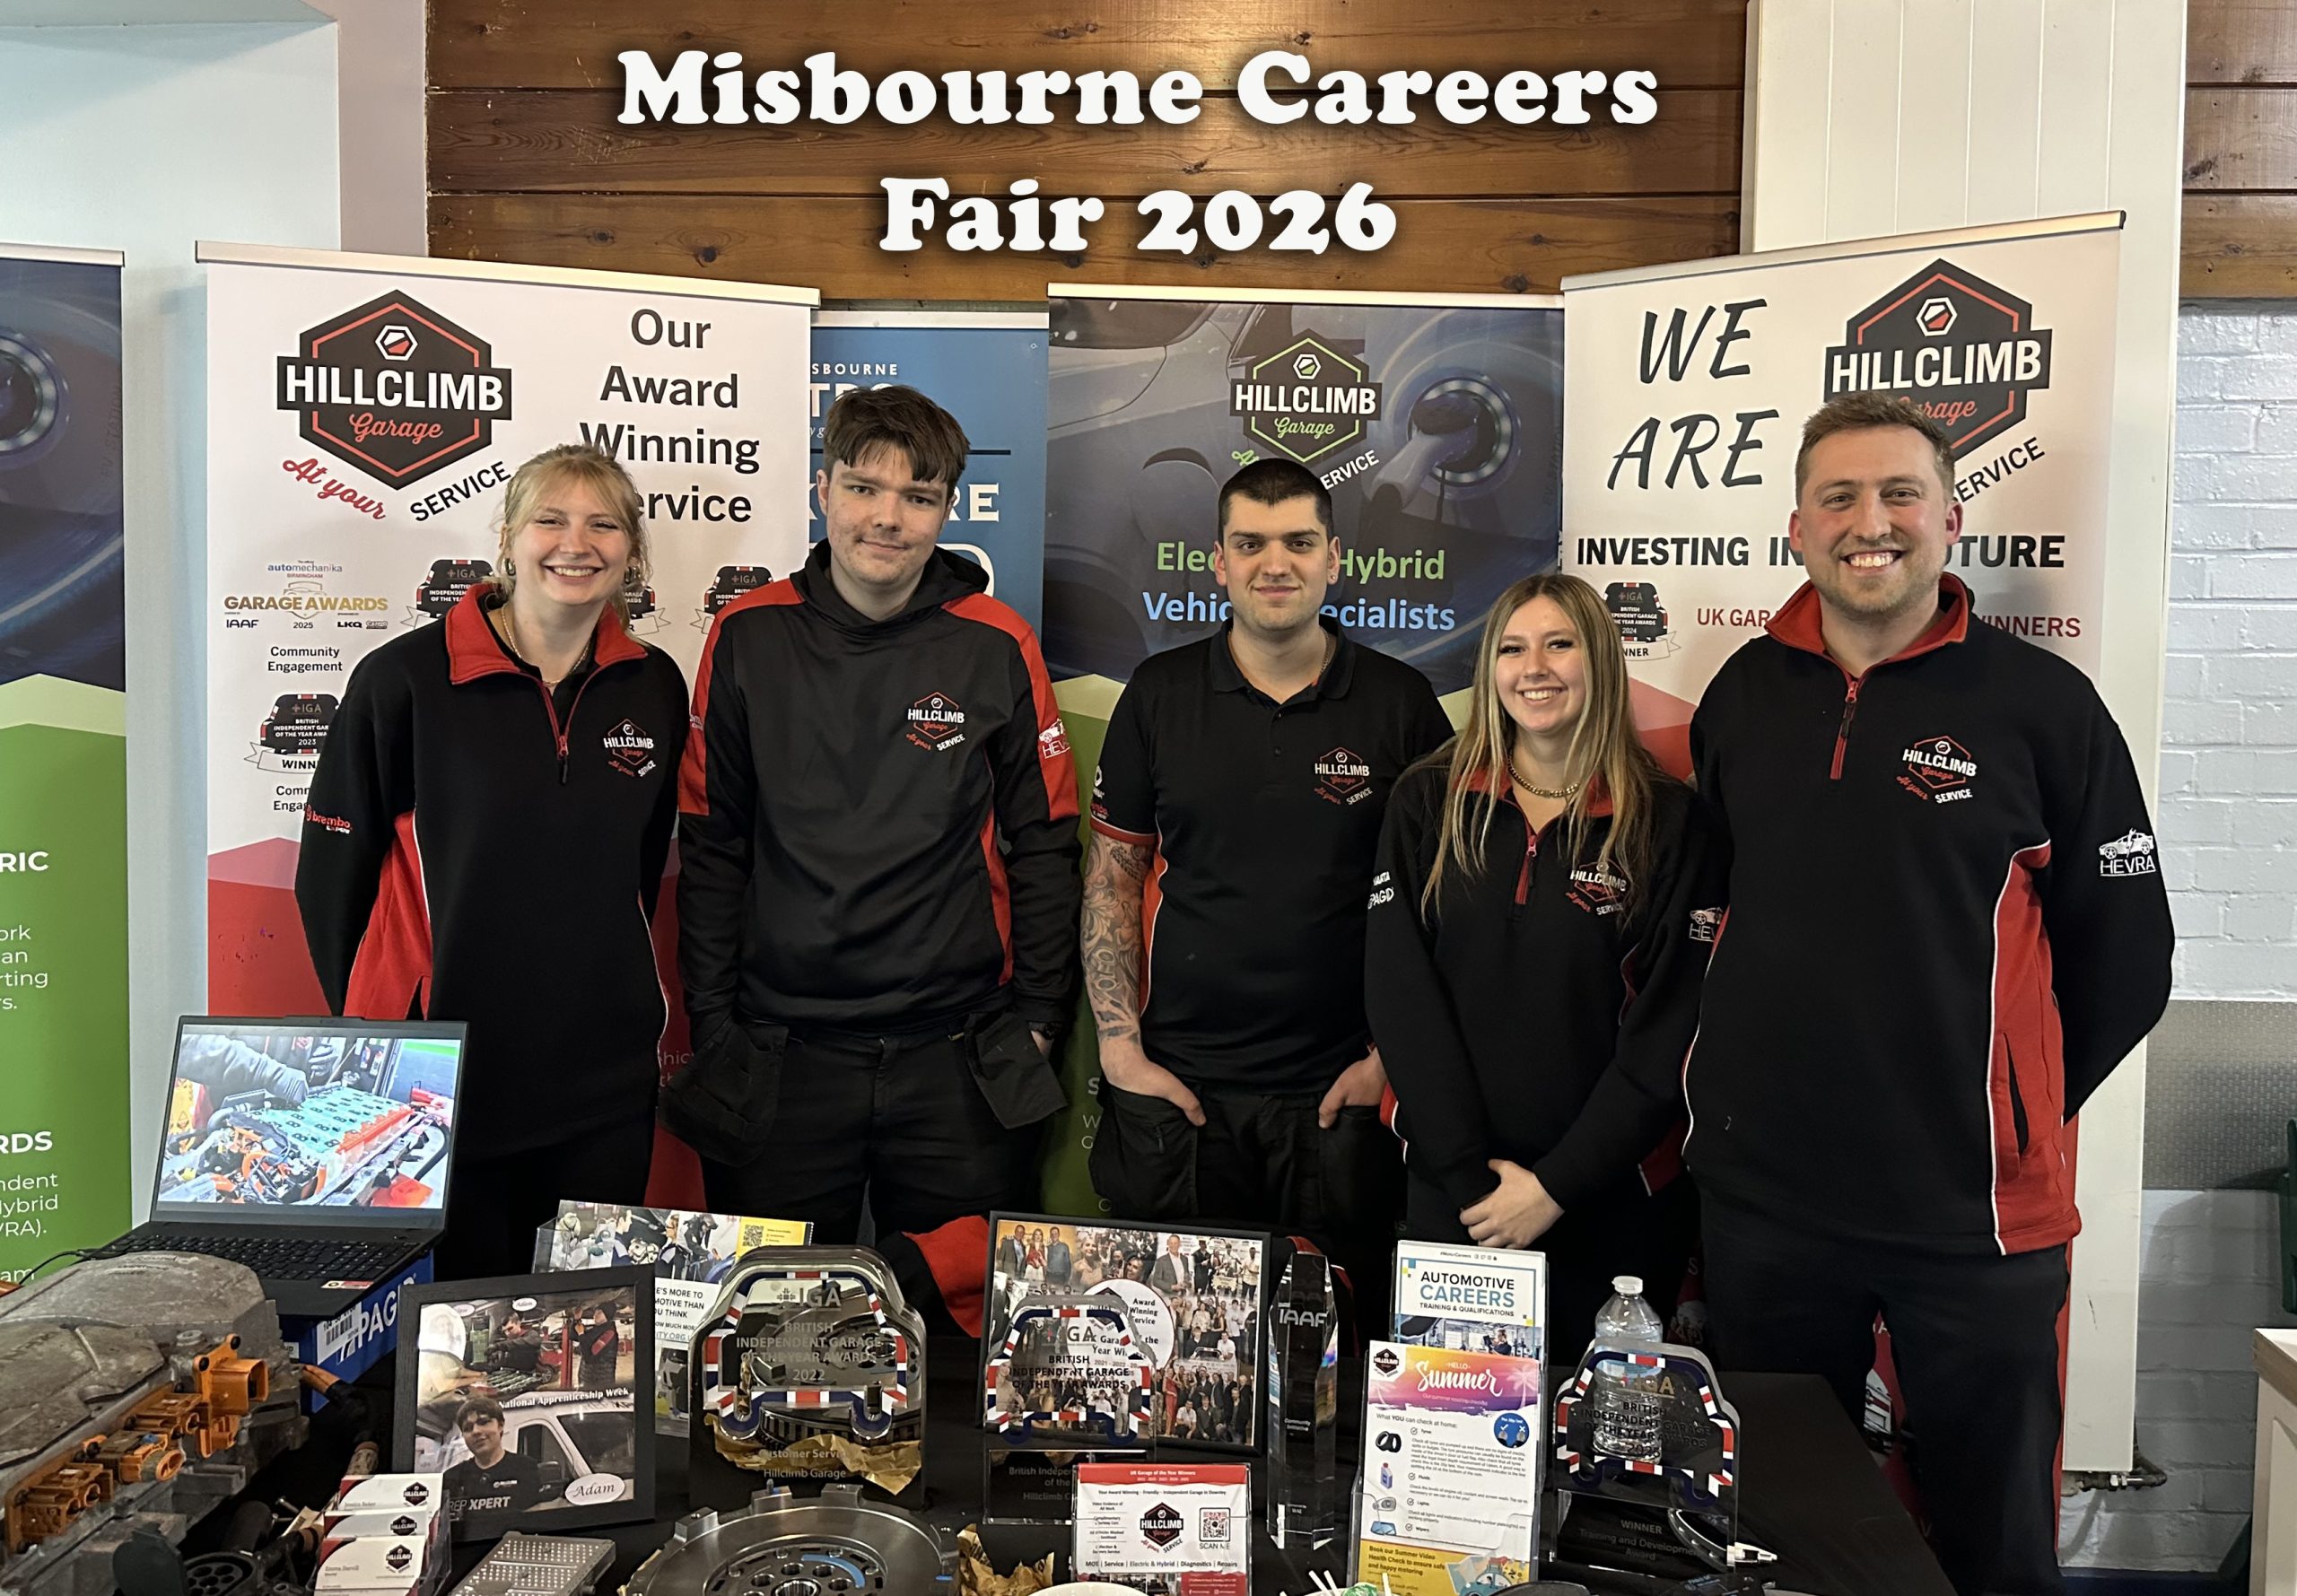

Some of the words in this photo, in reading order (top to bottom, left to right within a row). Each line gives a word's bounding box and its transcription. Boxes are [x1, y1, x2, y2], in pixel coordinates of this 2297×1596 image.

[631, 309, 711, 348] Our
[1640, 298, 1768, 384] WE
[812, 362, 897, 376] SBOURNE
[1831, 340, 2042, 393] HILLCLIMB
[286, 364, 503, 412] HILLCLIMB
[600, 365, 738, 408] Award
[1236, 384, 1376, 415] HILLCLIMB
[349, 413, 443, 445] Garage
[1274, 416, 1335, 439] Garage
[580, 422, 760, 475] Winning
[1606, 409, 1779, 490] ARE
[1320, 449, 1379, 490] ERVICE
[1954, 437, 2045, 502] ERVICE
[283, 458, 328, 484] At
[318, 476, 386, 520] your
[410, 461, 511, 521] SERVICE
[639, 485, 752, 522] rvice
[1157, 541, 1217, 571] Elec
[1577, 536, 1749, 566] INVESTING
[1945, 535, 2065, 567] TURE
[267, 563, 343, 572] automechanika
[457, 570, 476, 578] IGA
[740, 575, 756, 583] IGA
[224, 596, 302, 610] GARAGE
[305, 597, 389, 611] AWARDS
[1626, 592, 1643, 601] IGA
[1142, 591, 1233, 623] Vehic
[1319, 597, 1454, 630] ecialists
[1697, 608, 1725, 626] UK
[1730, 608, 1780, 627] GAR
[226, 619, 259, 628] IAAF
[270, 646, 340, 658] Community
[268, 661, 343, 674] Engagement
[301, 704, 322, 713] IGA
[907, 709, 965, 724] HILLCLIMB
[603, 737, 654, 749] HILLCLIMB
[936, 733, 966, 752] SERVICE
[1042, 740, 1070, 757] HEV
[1314, 763, 1370, 777] HILLCLIMB
[1902, 748, 1978, 777] HILLCLIMB
[1921, 766, 1954, 781] Garage
[1346, 787, 1373, 805] SERVICE
[1935, 789, 1973, 804] SERVICE
[0, 850, 49, 873] RIC
[2100, 855, 2155, 875] HEVRA
[0, 924, 31, 941] ork
[0, 1130, 53, 1154] RDS
[1420, 1270, 1515, 1290] AUTOMOTIVE
[669, 1288, 691, 1298] MORE
[694, 1291, 703, 1299] TO
[799, 1287, 842, 1306] IGA
[1419, 1284, 1515, 1308] CAREERS
[685, 1301, 704, 1310] THAN
[1132, 1298, 1156, 1306] Award
[1419, 1302, 1452, 1311] TRAINING
[1459, 1306, 1515, 1317] QUALIFICATIONS
[665, 1309, 688, 1318] THINK
[1130, 1307, 1158, 1316] Winning
[1279, 1308, 1326, 1328] IAAF
[784, 1321, 834, 1333] BRITISH
[736, 1337, 827, 1348] INDEPENDENT
[828, 1337, 883, 1347] GARAGE
[1145, 1336, 1158, 1344] the
[740, 1352, 758, 1363] OF
[761, 1352, 788, 1362] THE
[788, 1352, 820, 1362] YEAR
[823, 1351, 877, 1363] AWARDS
[1092, 1346, 1111, 1355] Year
[1048, 1356, 1090, 1365] BRITISH
[792, 1370, 825, 1382] 2022
[1009, 1367, 1084, 1376] INDEPENDENT
[1086, 1367, 1130, 1376] GARAGE
[1415, 1360, 1504, 1398] Summer
[1029, 1381, 1052, 1390] THE
[1079, 1381, 1126, 1390] AWARDS
[498, 1397, 536, 1409] National
[537, 1391, 604, 1407] Apprenticeship
[606, 1387, 629, 1398] Week
[1623, 1402, 1667, 1417] BRITISH
[1416, 1417, 1433, 1426] check
[1580, 1408, 1659, 1427] INDEPENDENT
[1664, 1420, 1712, 1435] GARAGE
[1603, 1424, 1625, 1435] THE
[1627, 1427, 1655, 1441] YEAR
[764, 1468, 808, 1478] Hillclimb
[810, 1469, 846, 1480] Garage
[1009, 1467, 1036, 1476] British
[570, 1482, 616, 1498] Adam
[1044, 1478, 1053, 1487] of
[1056, 1478, 1070, 1487] the
[468, 1496, 511, 1510] XPERT
[1023, 1492, 1063, 1501] Hillclimb
[1140, 1519, 1183, 1530] HILLCLIMB
[1620, 1519, 1663, 1534] WINNER
[1579, 1528, 1617, 1543] Training
[1619, 1535, 1637, 1546] and
[1163, 1539, 1183, 1553] SERVICE
[1368, 1554, 1387, 1563] Health
[1388, 1556, 1405, 1565] Check
[1395, 1548, 1418, 1557] Summer
[1419, 1552, 1436, 1560] Video
[1625, 1548, 1656, 1561] Award
[1157, 1560, 1175, 1568] Hybrid
[1380, 1564, 1396, 1573] happy
[1397, 1565, 1423, 1576] motoring
